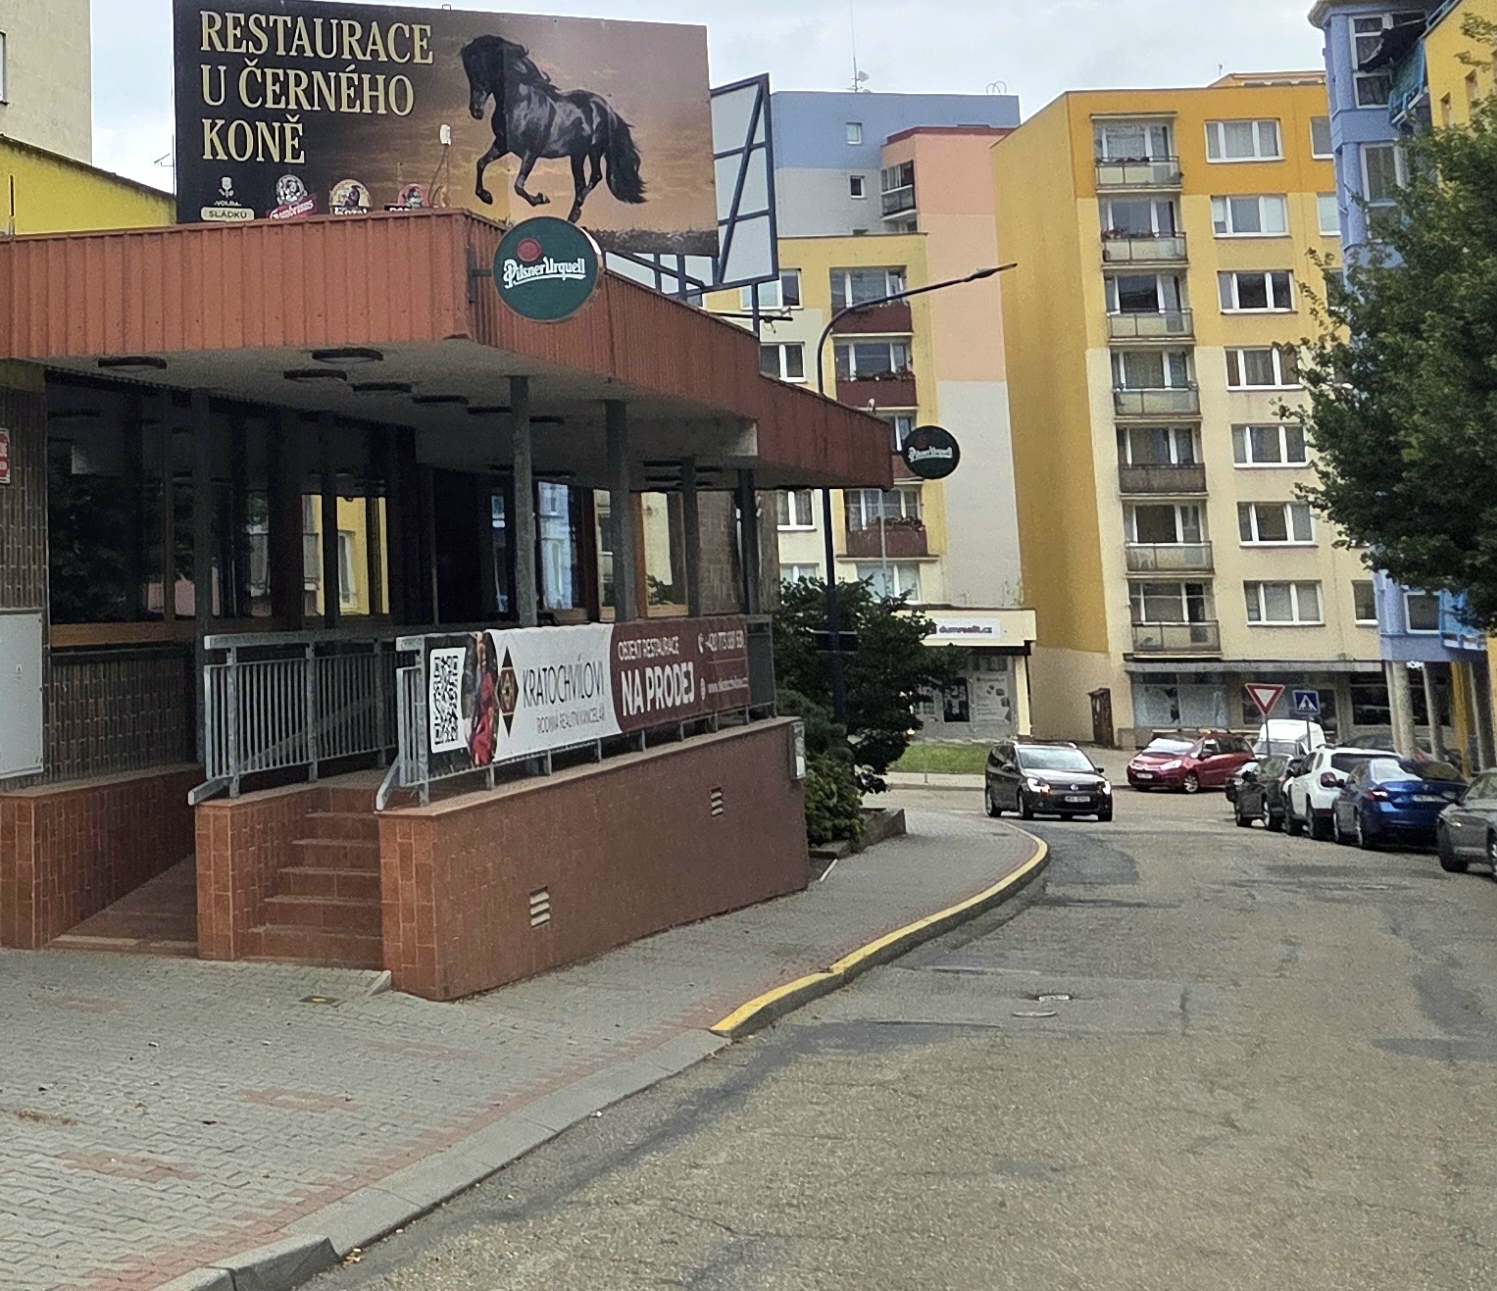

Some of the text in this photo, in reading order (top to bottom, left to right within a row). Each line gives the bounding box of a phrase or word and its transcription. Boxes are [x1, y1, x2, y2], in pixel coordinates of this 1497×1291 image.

[199, 10, 434, 64] RESTAURACE
[200, 57, 415, 117] U ČERNÉHO
[201, 113, 305, 164] KONĚ
[503, 256, 586, 289] Pilsner Urquell
[621, 661, 695, 717] NA PRODEJ
